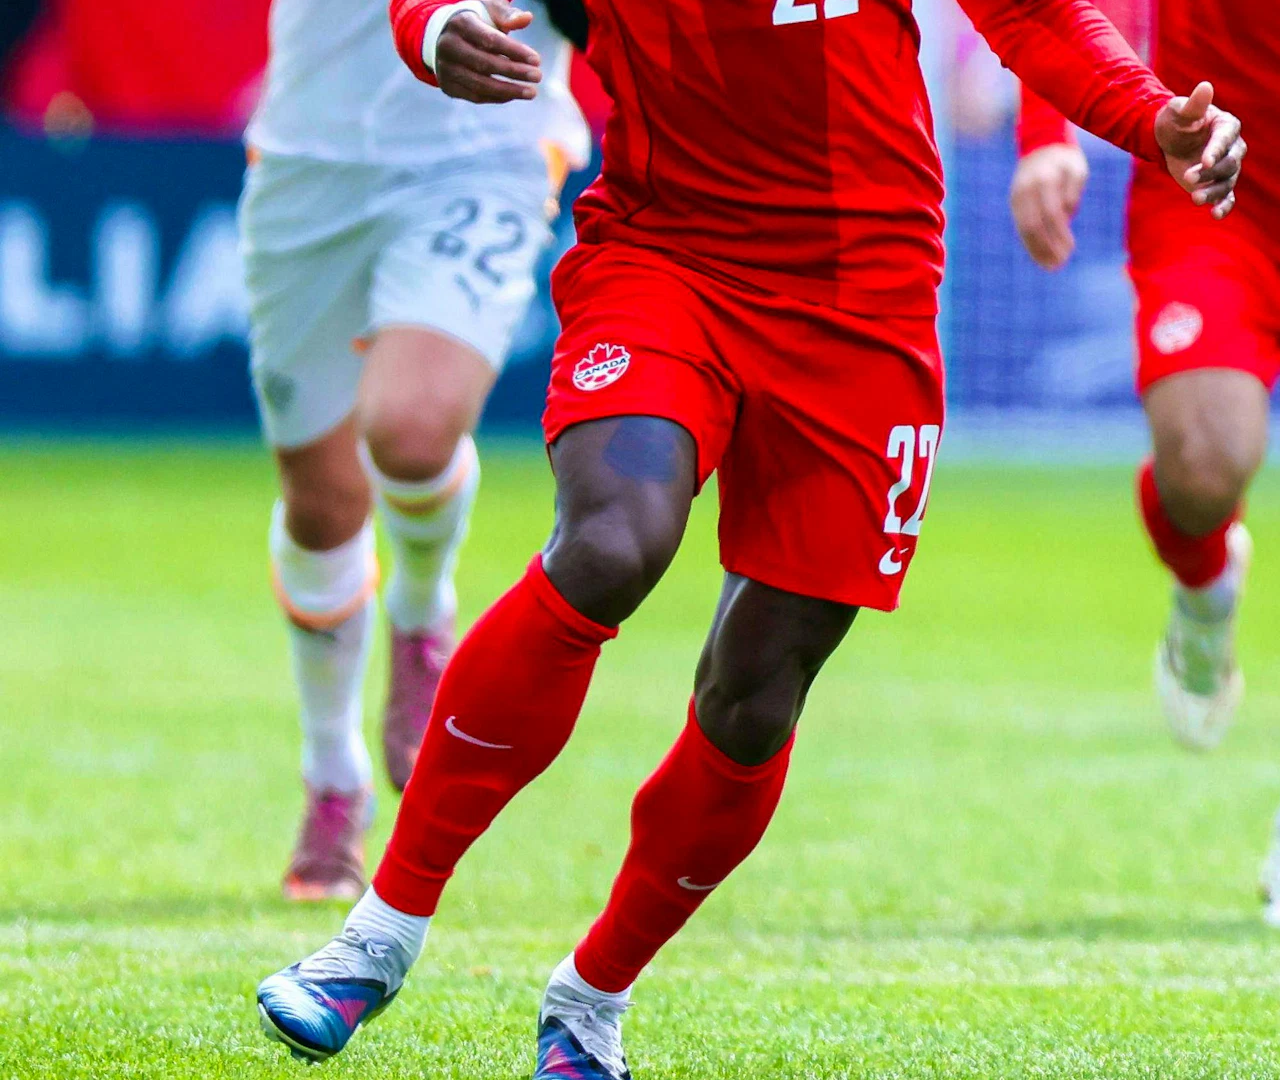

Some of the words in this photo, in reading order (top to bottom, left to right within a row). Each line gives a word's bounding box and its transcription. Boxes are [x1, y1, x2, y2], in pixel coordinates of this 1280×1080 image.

[430, 198, 527, 287] 22
[575, 357, 627, 381] CANADA
[883, 424, 940, 536] 22
